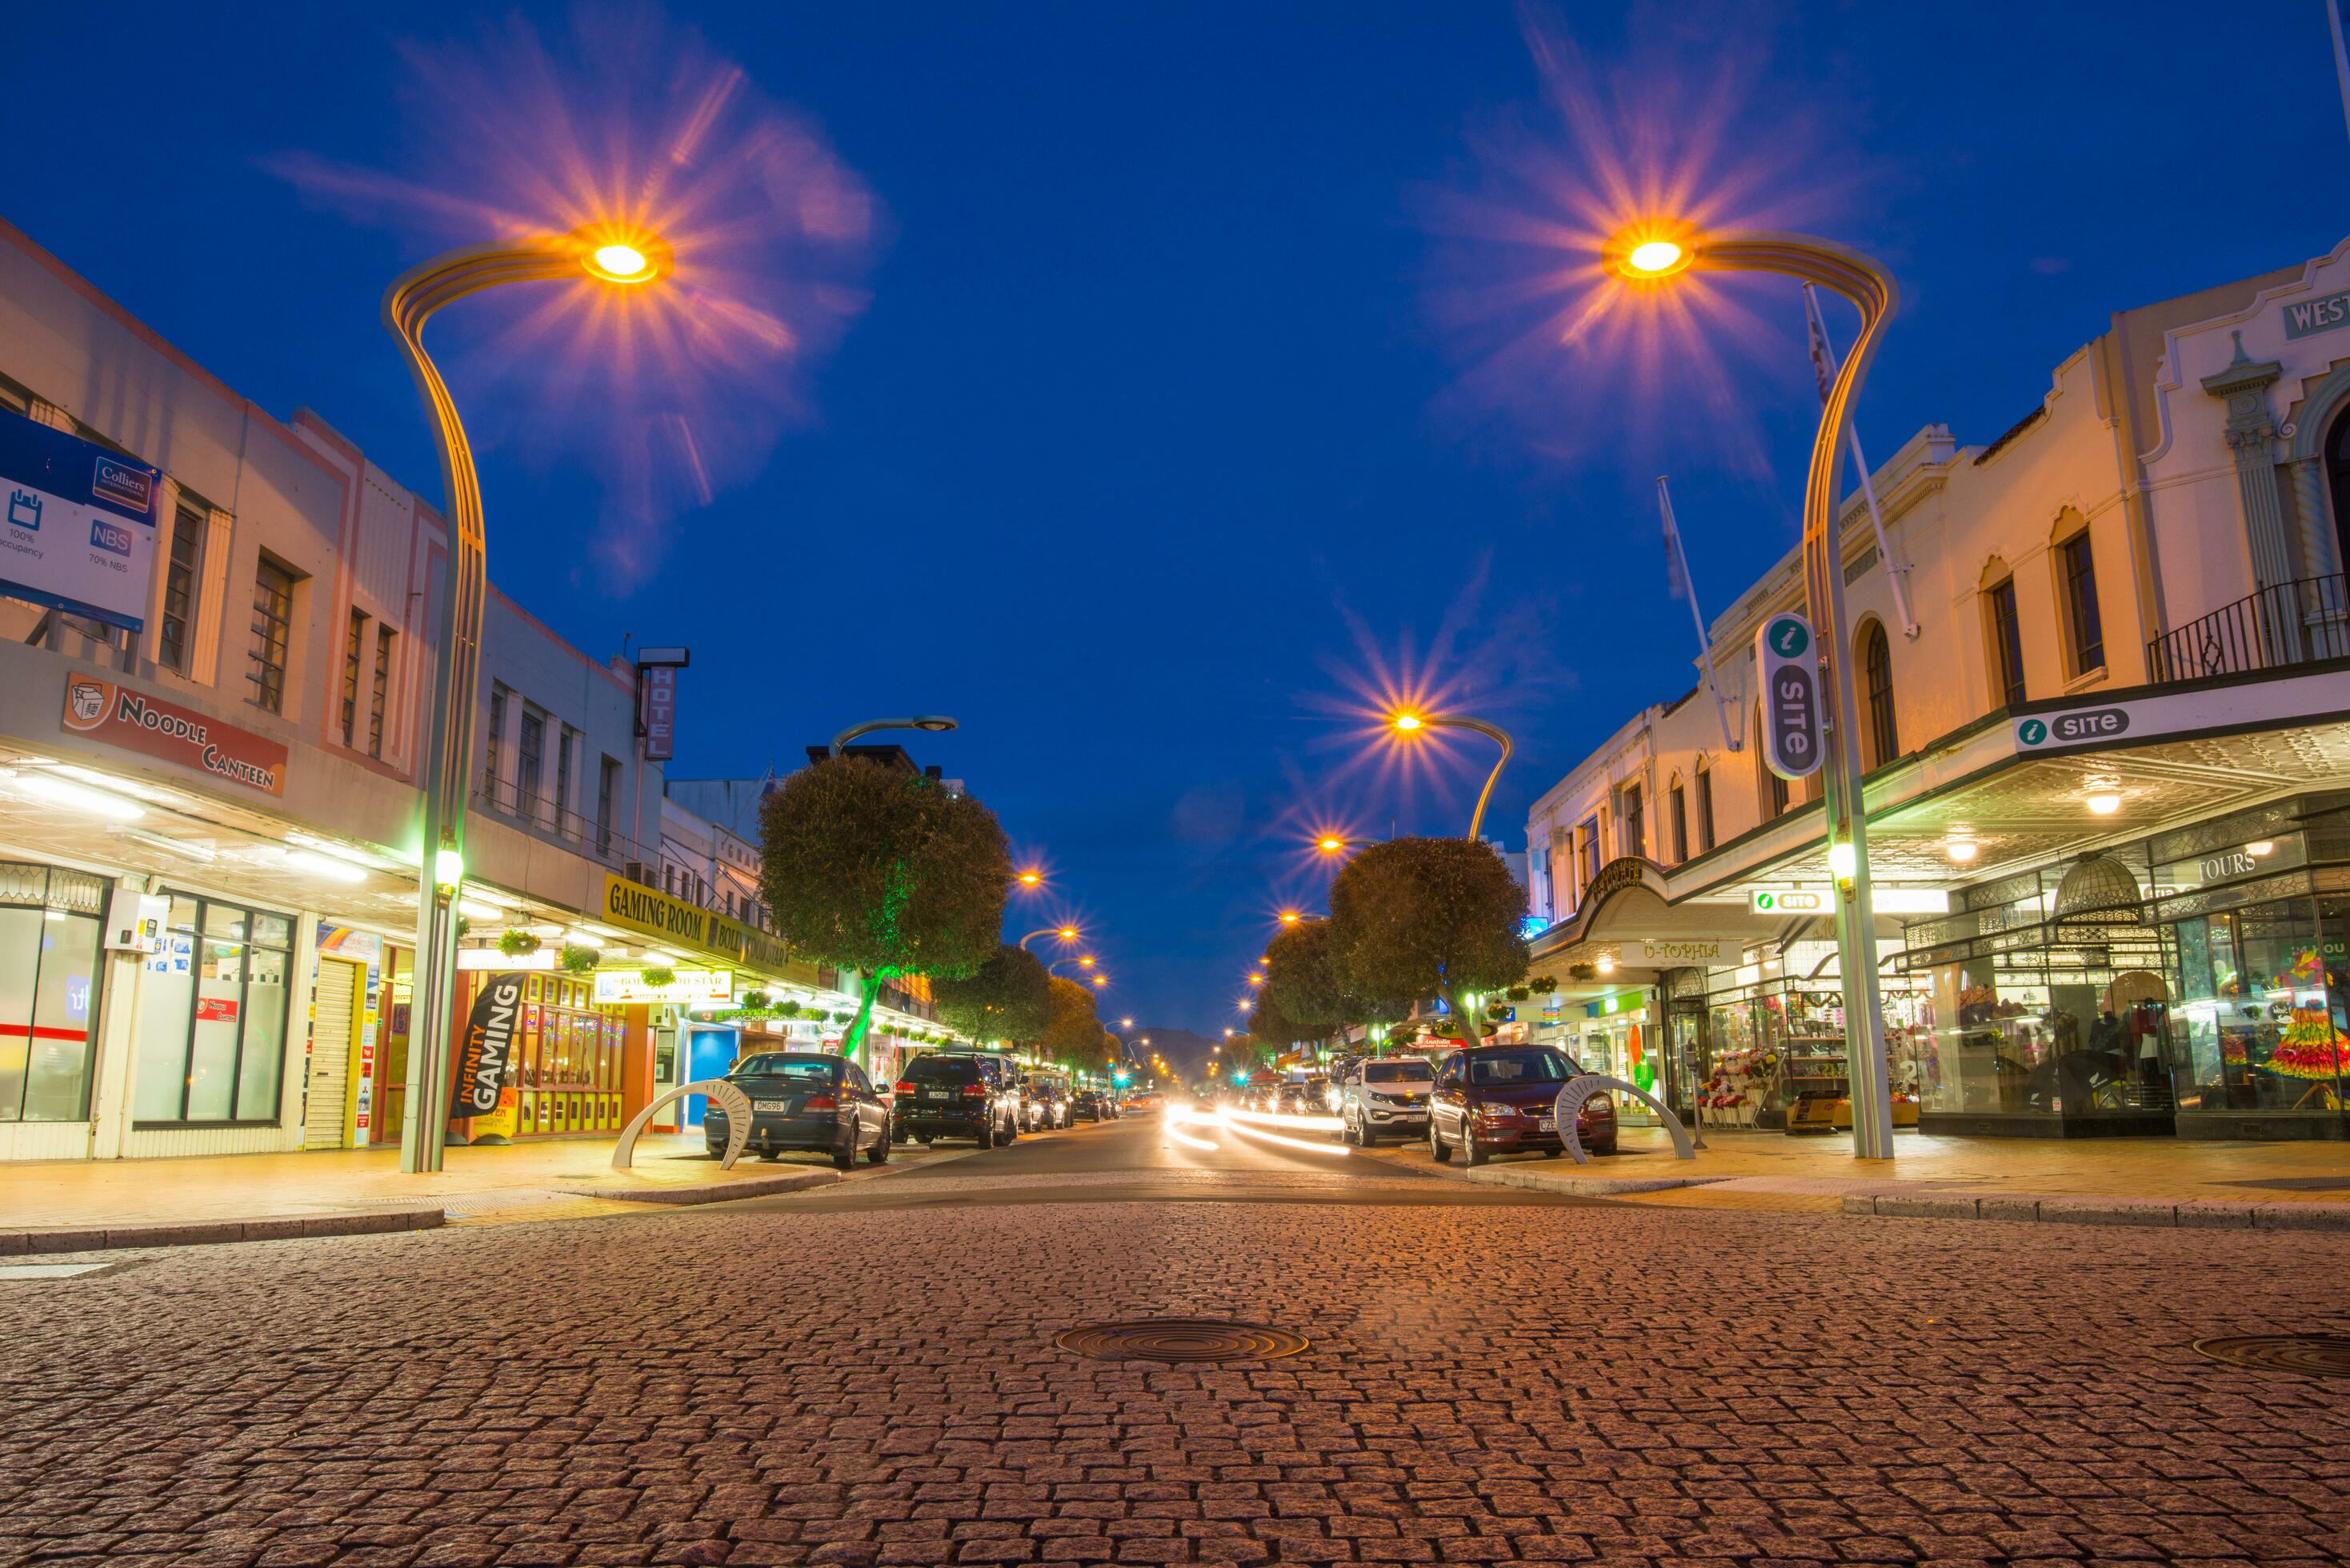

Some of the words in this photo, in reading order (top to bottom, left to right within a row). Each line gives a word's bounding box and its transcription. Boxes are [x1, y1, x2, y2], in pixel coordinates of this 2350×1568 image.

[101, 479, 144, 498] INTERNATIONAL
[102, 466, 146, 492] Colliers
[10, 528, 35, 544] 100%
[94, 526, 129, 550] NBS
[89, 554, 107, 567] 70%
[110, 562, 128, 573] NBS
[649, 670, 673, 755] HOTEL
[2196, 850, 2256, 882] TOURS
[610, 883, 665, 929] GAMING
[667, 904, 703, 942] ROOM
[1643, 943, 1720, 960] U-TOPHIA
[474, 986, 518, 1110] GAMING
[460, 1024, 486, 1103] INFINITY
[757, 1102, 781, 1110] DMG96
